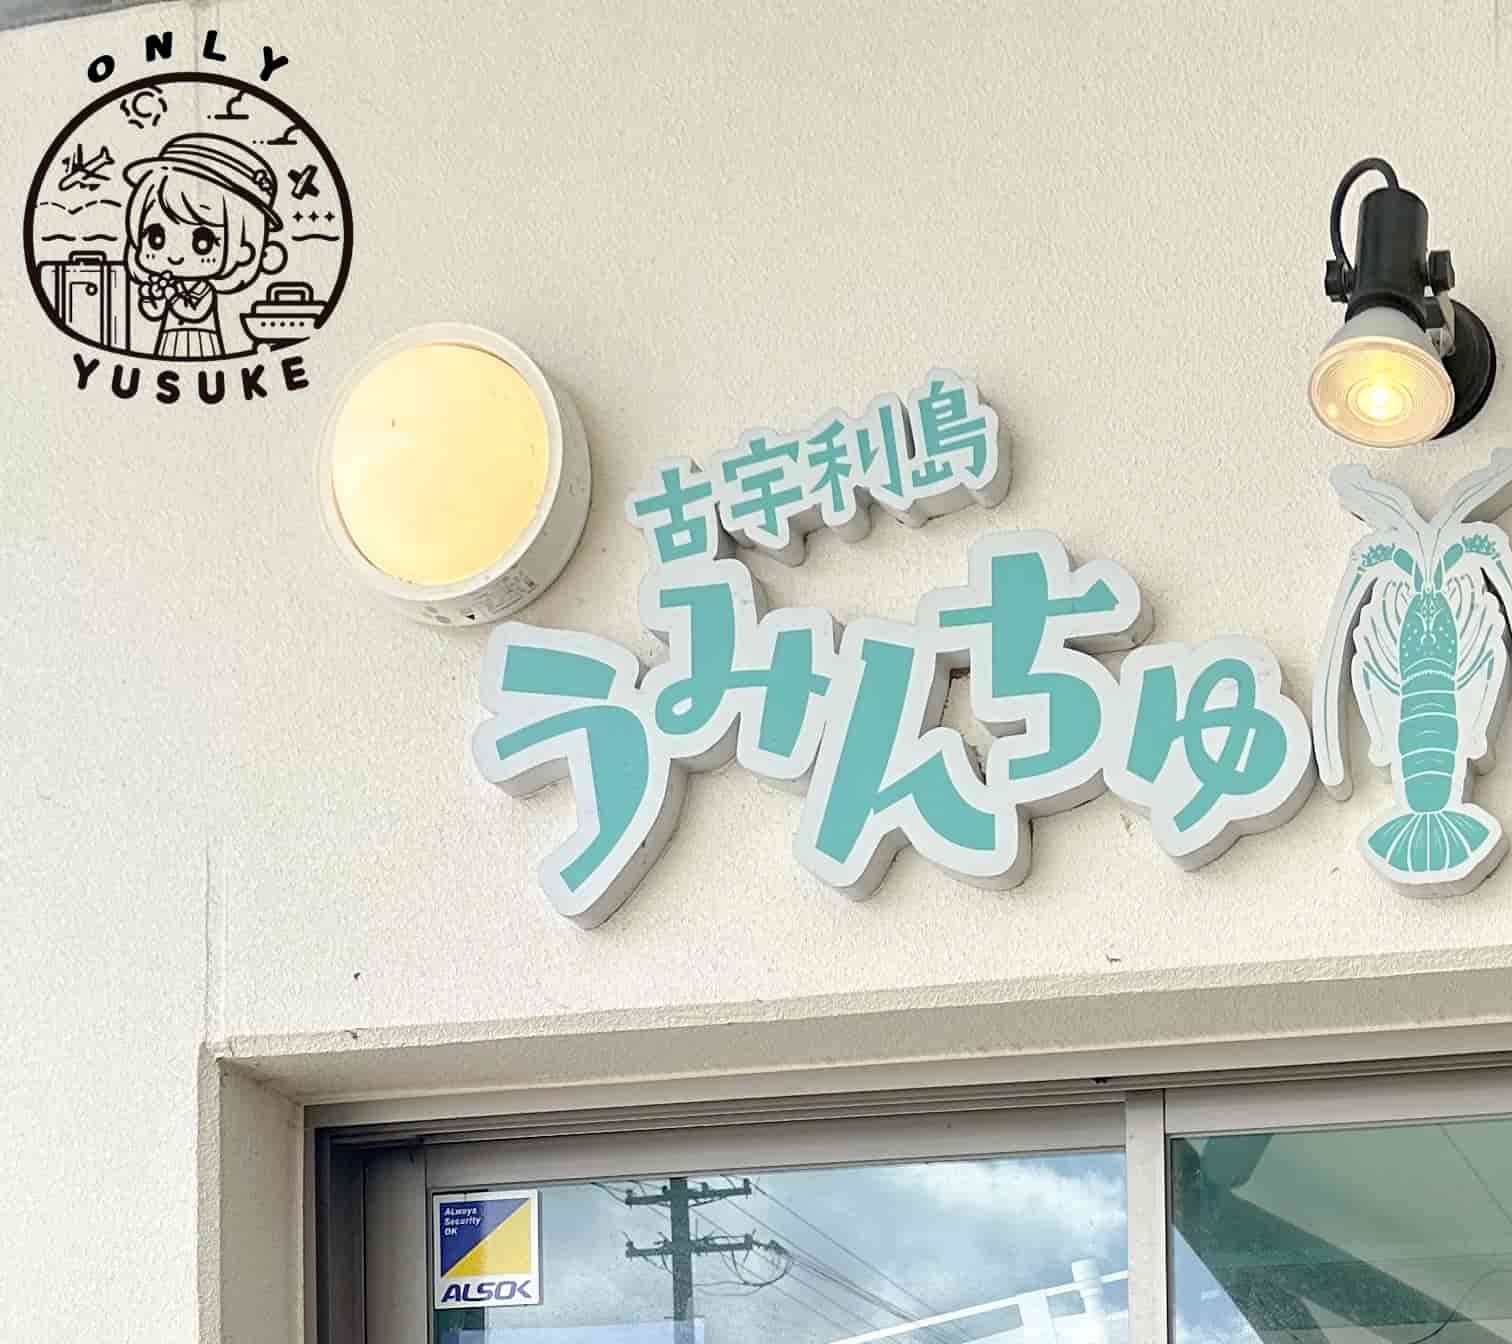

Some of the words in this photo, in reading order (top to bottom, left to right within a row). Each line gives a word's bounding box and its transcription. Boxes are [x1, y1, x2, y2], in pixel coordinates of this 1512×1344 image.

[636, 382, 998, 562] 古宇利島
[497, 554, 1287, 893] うみんちゅ
[444, 1217, 481, 1226] Security
[444, 1227, 458, 1236] OK
[441, 1280, 532, 1302] ALSOK
